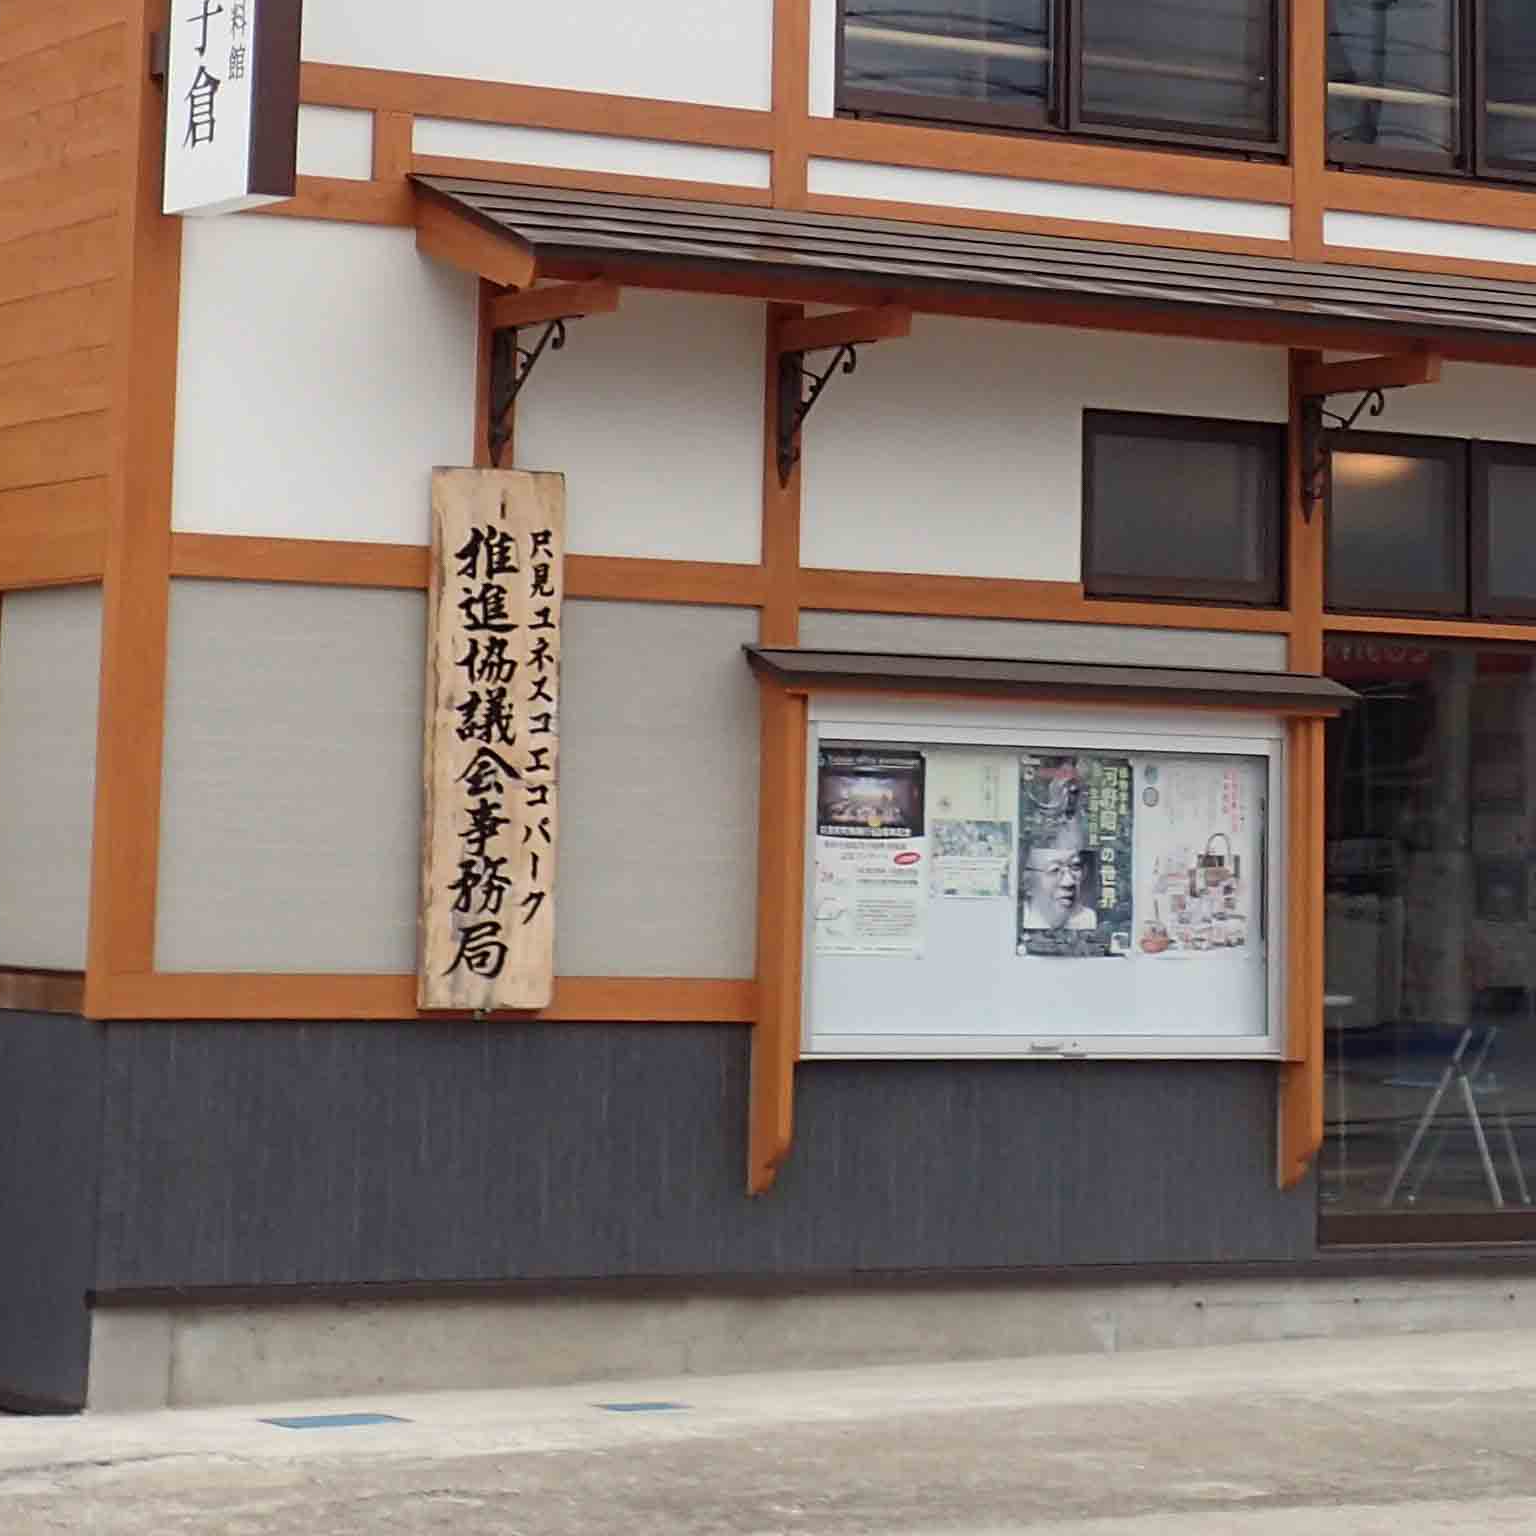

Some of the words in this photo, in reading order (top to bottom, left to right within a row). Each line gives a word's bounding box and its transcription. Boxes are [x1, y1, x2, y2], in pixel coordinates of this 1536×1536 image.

[445, 524, 523, 979] 推進協議会事務局
[520, 528, 557, 925] 只見ユネスコエコパーク
